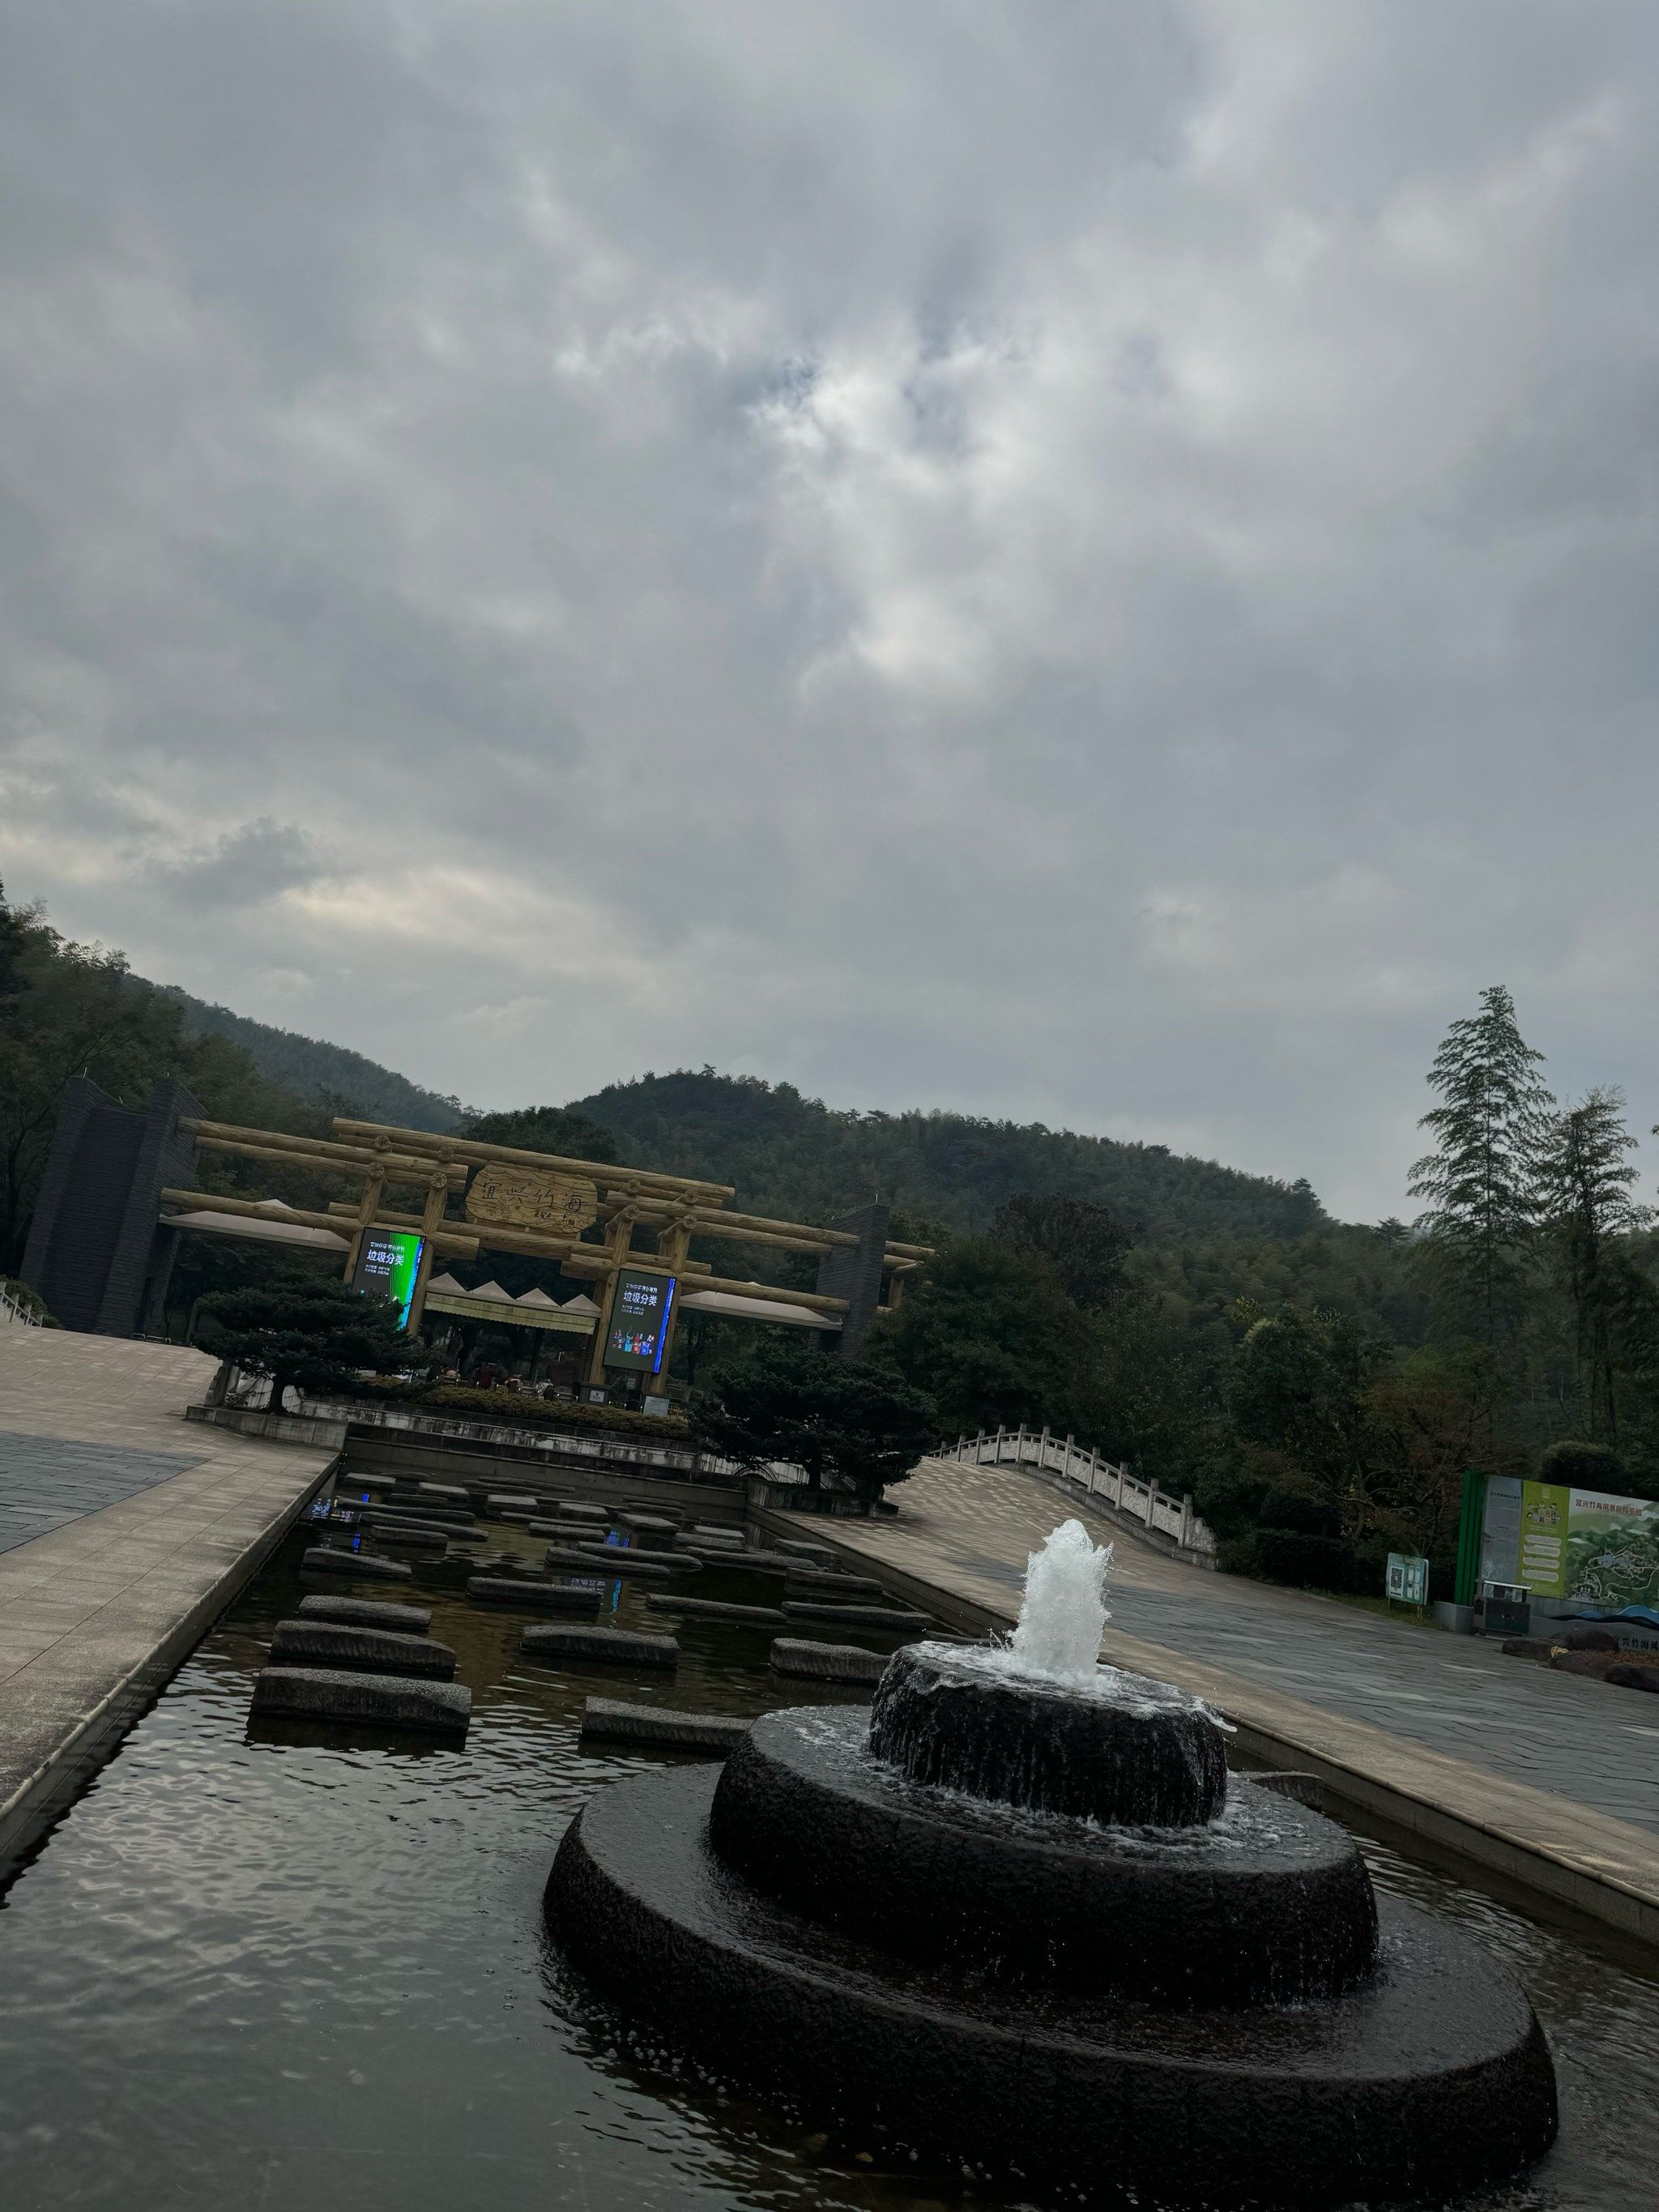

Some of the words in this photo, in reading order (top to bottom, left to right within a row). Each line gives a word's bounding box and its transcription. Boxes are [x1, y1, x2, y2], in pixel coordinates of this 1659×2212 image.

[482, 1179, 591, 1212] 宜兴竹海
[367, 1249, 404, 1266] 垃圾分类
[623, 1291, 658, 1306] 垃圾分类
